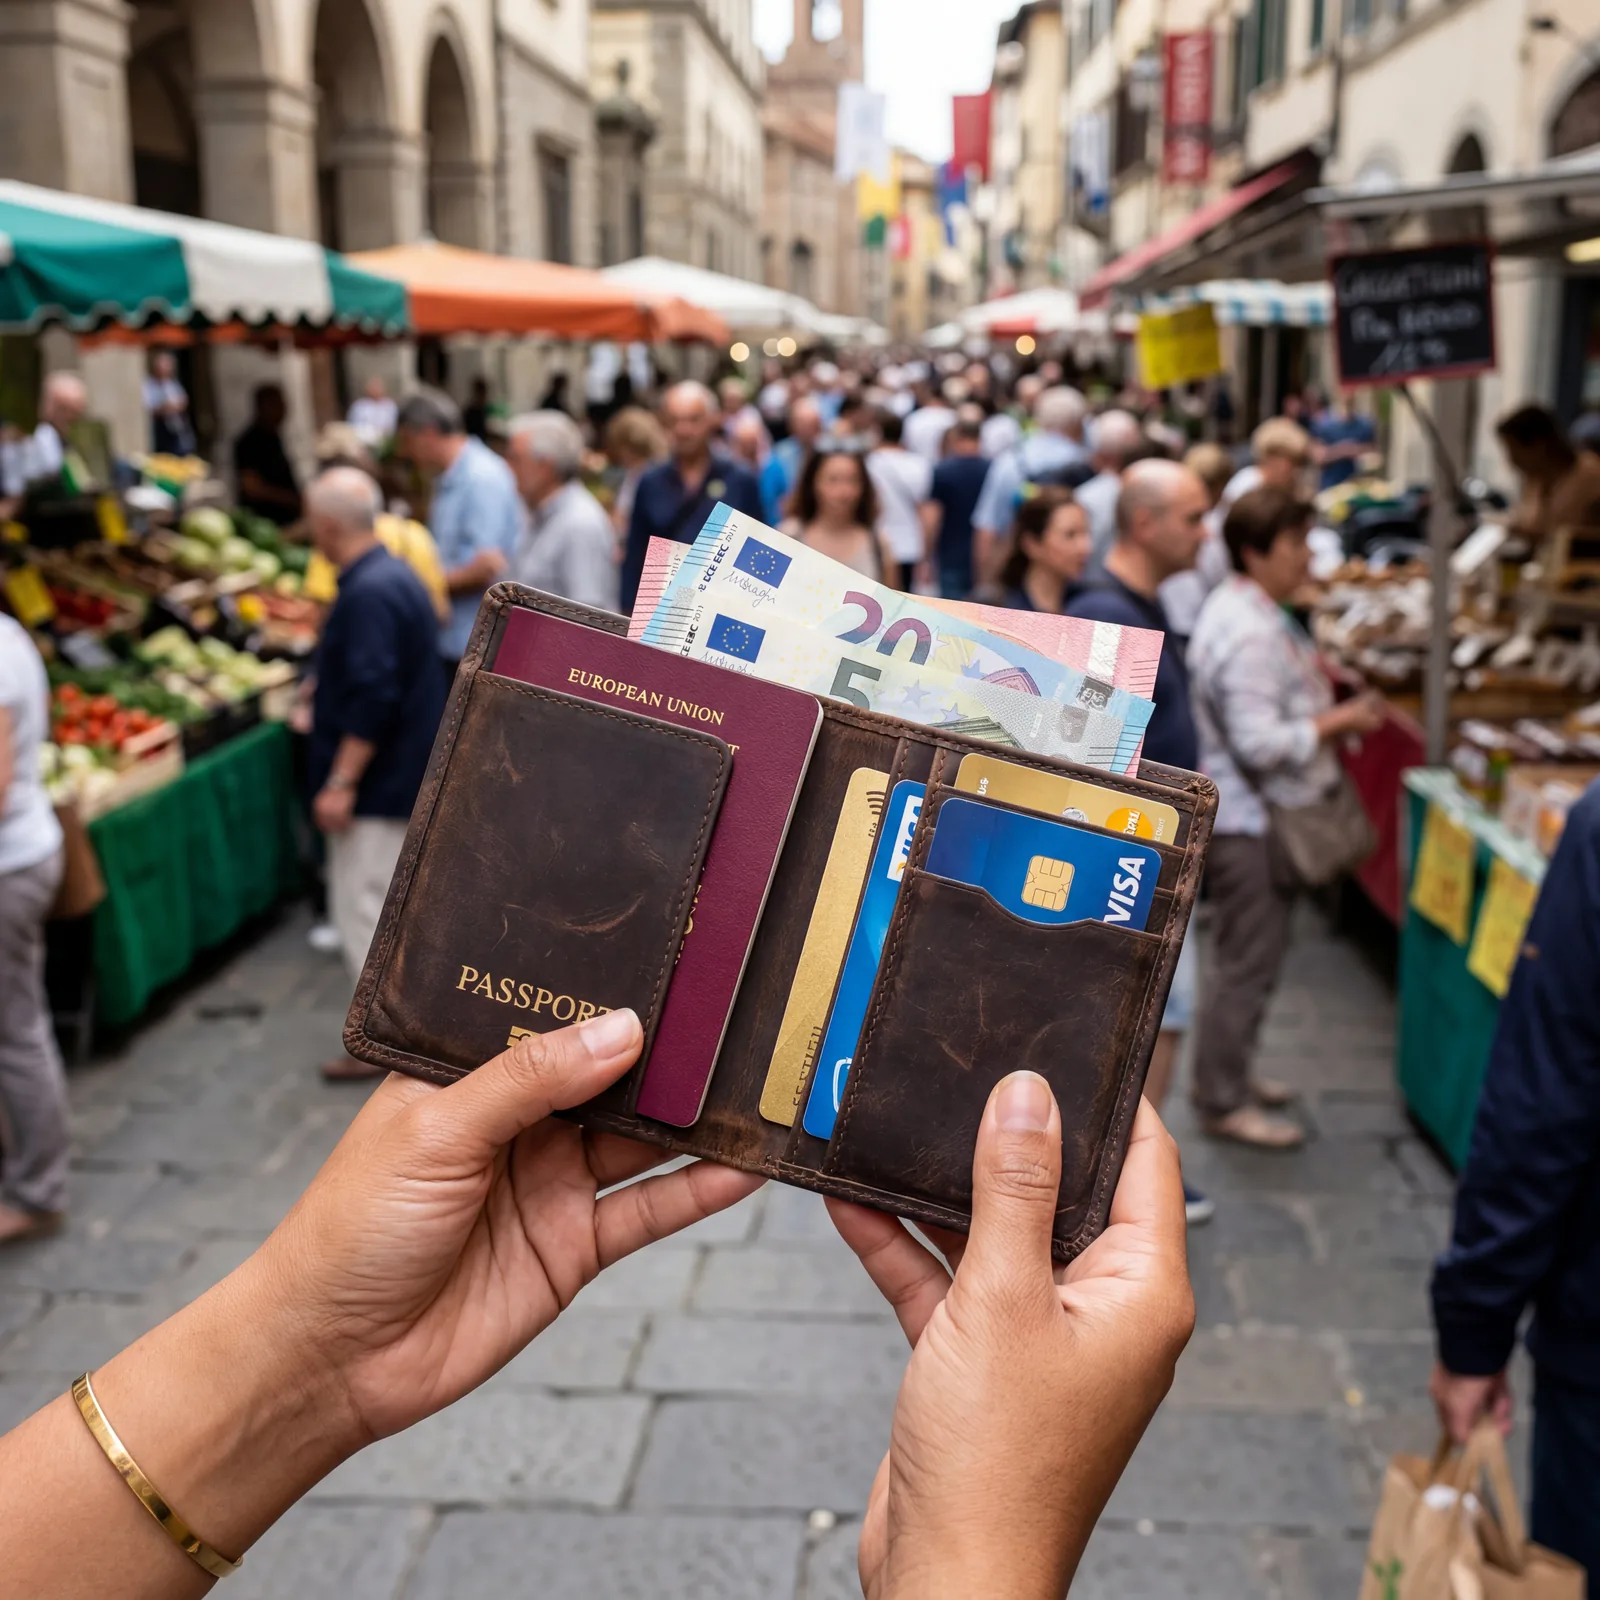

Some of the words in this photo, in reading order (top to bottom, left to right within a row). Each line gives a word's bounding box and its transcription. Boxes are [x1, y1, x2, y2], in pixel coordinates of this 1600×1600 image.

[835, 590, 931, 666] 20
[567, 667, 663, 708] EUROPEAN
[667, 696, 725, 726] UNION
[829, 656, 882, 711] 5
[1103, 857, 1146, 923] VISA
